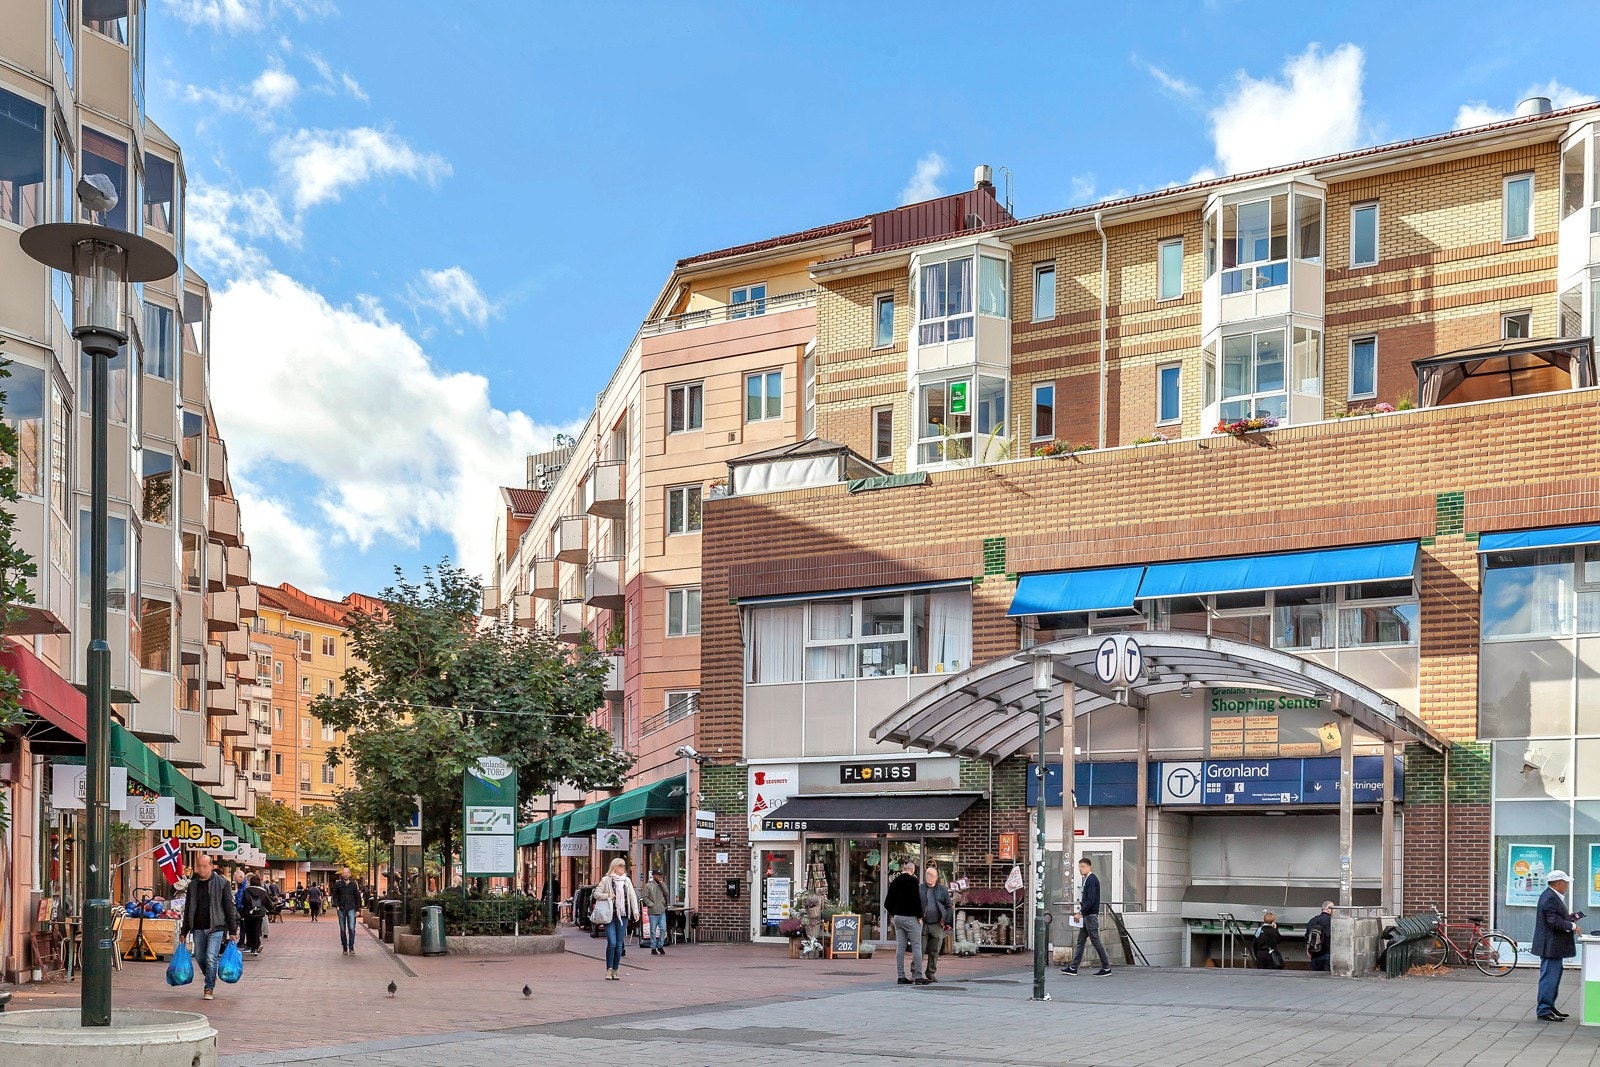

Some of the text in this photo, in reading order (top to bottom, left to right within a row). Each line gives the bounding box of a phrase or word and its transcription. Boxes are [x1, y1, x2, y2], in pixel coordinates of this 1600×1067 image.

[1102, 648, 1114, 676] T
[1127, 648, 1137, 676] T
[1211, 696, 1324, 713] Shopping Senter
[845, 766, 911, 780] FLORISS
[1207, 763, 1270, 777] Grønland
[1174, 775, 1189, 794] T
[765, 821, 808, 830] FLORISS
[888, 822, 950, 831] Tlf. 22 17 58 50
